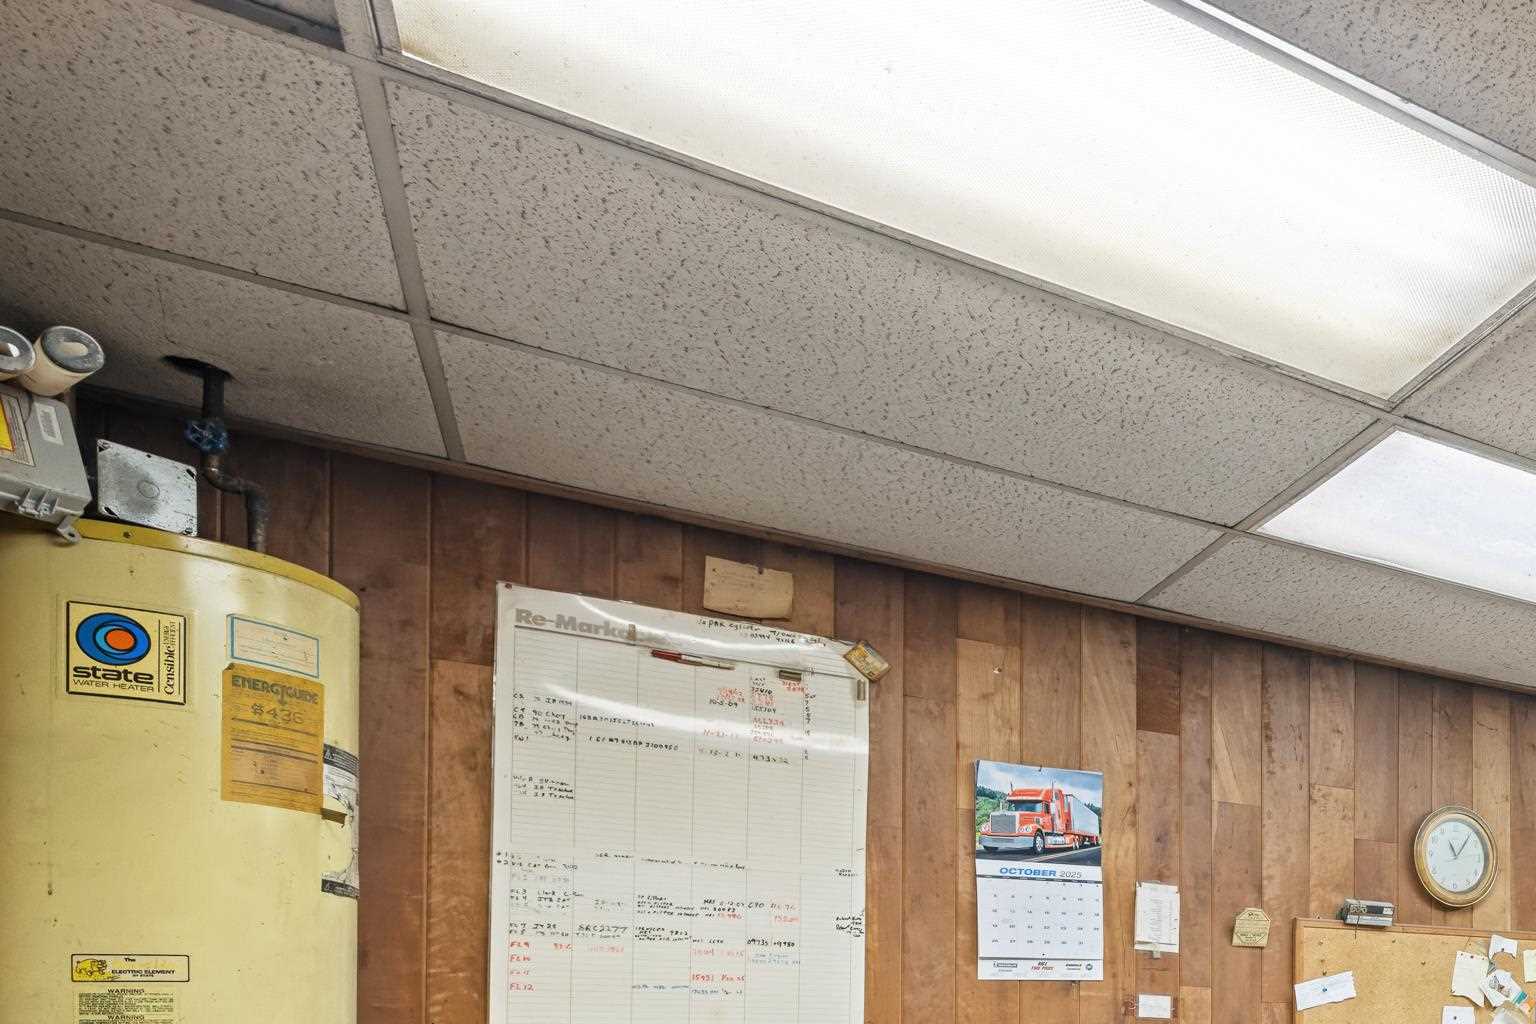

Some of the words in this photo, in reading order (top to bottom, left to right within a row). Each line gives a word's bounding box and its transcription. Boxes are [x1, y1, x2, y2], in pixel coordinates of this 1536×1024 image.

[73, 665, 154, 685] state
[73, 679, 109, 688] WATER
[113, 683, 154, 692] HEATER
[1000, 867, 1057, 877] OCTOBER
[1060, 871, 1082, 879] 2025
